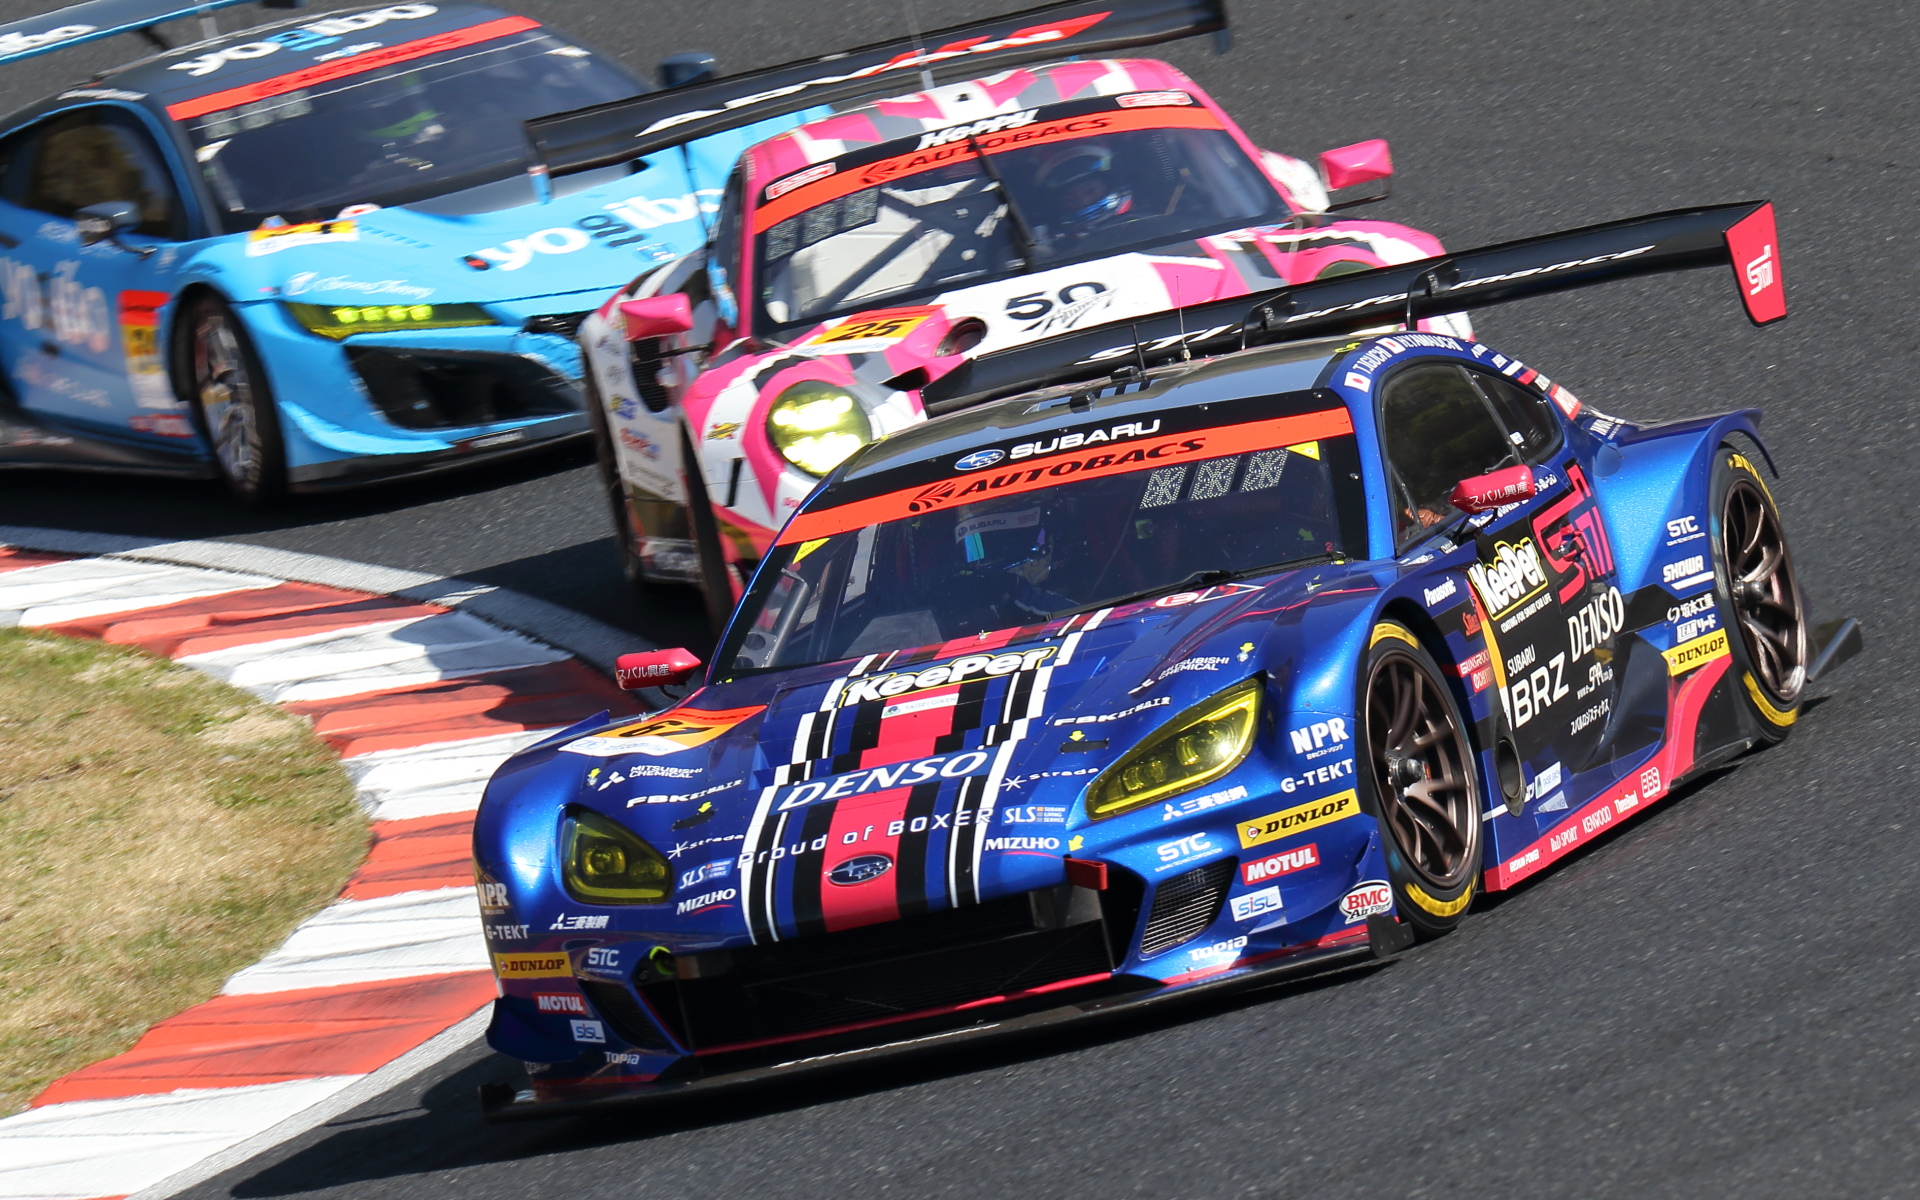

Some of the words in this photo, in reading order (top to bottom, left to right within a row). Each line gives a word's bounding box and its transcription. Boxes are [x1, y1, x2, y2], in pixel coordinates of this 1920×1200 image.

[826, 318, 914, 343] 25
[1009, 418, 1161, 461] SUBARU
[961, 436, 1207, 500] AUTOBACS
[1468, 481, 1529, 507] スバル興産
[1666, 515, 1699, 538] STC
[1662, 555, 1704, 583] SHOWA
[1423, 576, 1457, 608] Panasonic
[1567, 586, 1626, 664] DENSO
[1507, 644, 1536, 678] SUBARU
[1677, 636, 1726, 665] DUNLOP
[617, 663, 670, 680] スバル興産
[843, 648, 1050, 707] KeePer
[1511, 651, 1570, 729] BRZ
[1289, 717, 1350, 755] NPR
[628, 770, 693, 779] CHEMICAL
[630, 764, 703, 775] MITSUBISHI
[776, 751, 992, 811] DENSO
[1280, 758, 1353, 793] G-TEKT
[1004, 806, 1036, 824] SLS
[1265, 797, 1350, 835] DUNLOP
[1581, 805, 1612, 834] KENWOOD
[737, 834, 828, 869] Proud
[842, 825, 874, 845] of
[887, 808, 994, 837] BOXER
[984, 836, 1061, 851] MIZUHO
[1156, 831, 1212, 862] STC
[679, 865, 707, 890] SLS
[1246, 854, 1316, 882] MOTUL
[477, 882, 510, 907] NPR
[676, 888, 737, 915] MIZUHO
[1345, 886, 1389, 912] BMC
[1349, 900, 1371, 920] Air
[486, 924, 531, 940] G-TEKT
[509, 958, 566, 972] DUNLOP
[587, 947, 620, 967] STC
[537, 995, 584, 1012] MOTUL
